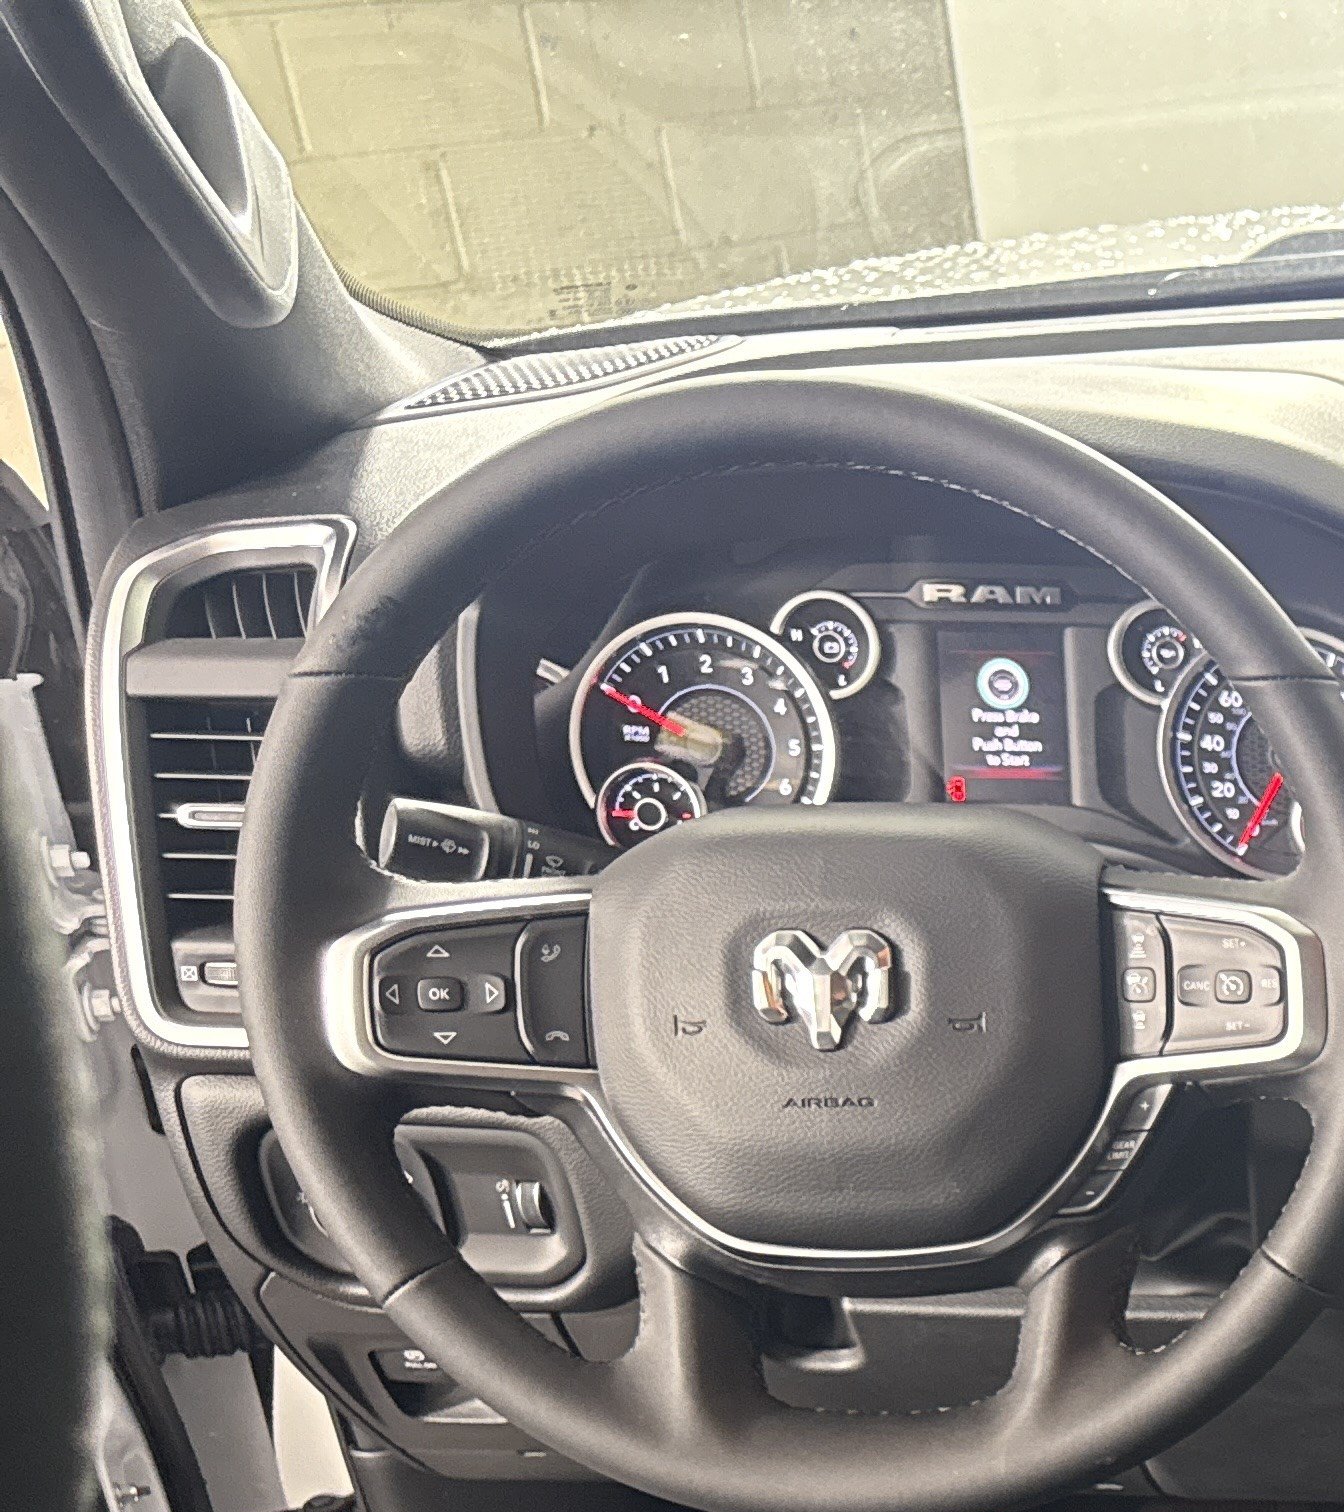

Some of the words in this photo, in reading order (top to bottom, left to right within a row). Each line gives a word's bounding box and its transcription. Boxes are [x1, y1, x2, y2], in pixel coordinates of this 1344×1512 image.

[922, 582, 1063, 605] RAM
[700, 655, 714, 674] 2
[657, 665, 669, 684] 1
[741, 667, 755, 686] 3
[773, 698, 788, 715] 4
[1217, 690, 1243, 708] 60
[788, 739, 801, 756] 5
[1200, 734, 1225, 752] 40
[779, 779, 793, 796] 6
[1210, 780, 1236, 798] 20
[407, 833, 432, 848] MIST
[428, 987, 450, 1001] OK
[1183, 980, 1211, 992] CANC
[782, 1096, 877, 1109] AIRBAG
